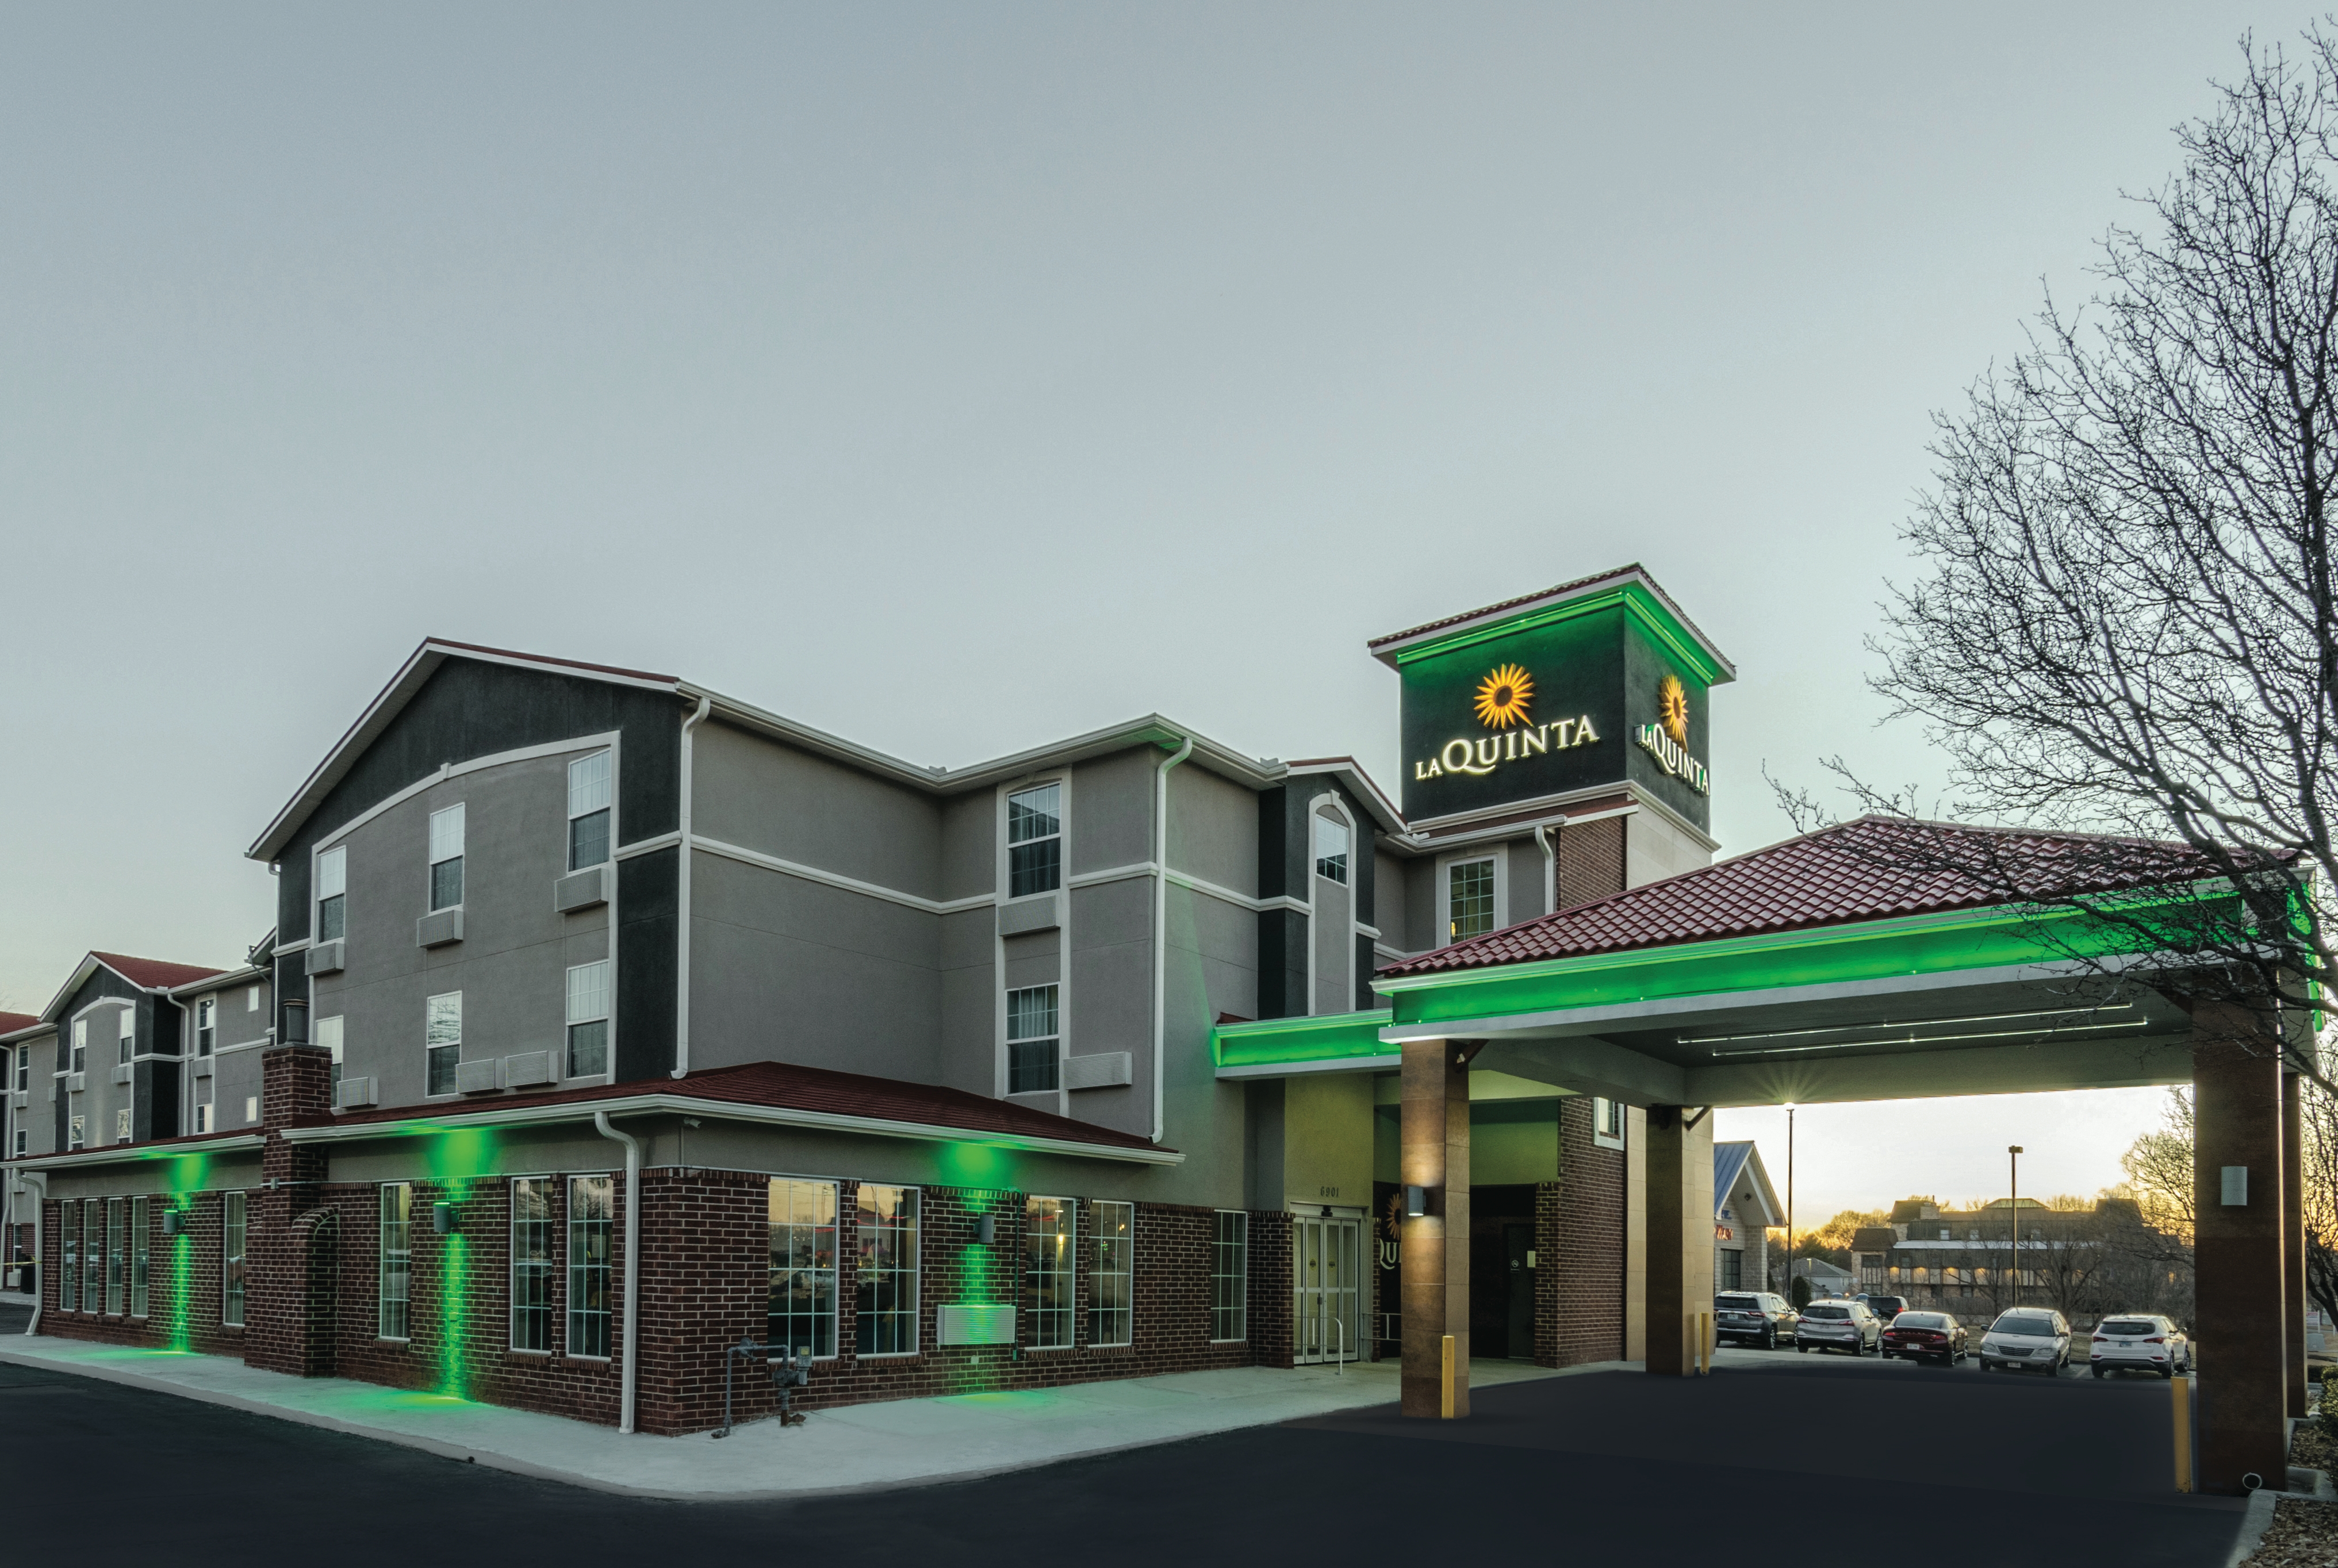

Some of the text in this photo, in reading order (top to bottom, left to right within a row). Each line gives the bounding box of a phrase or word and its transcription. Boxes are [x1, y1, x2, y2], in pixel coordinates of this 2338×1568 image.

[1416, 714, 1600, 780] LA QUINTA
[1641, 722, 1710, 797] LA QUINTA
[1320, 1186, 1339, 1198] 6901
